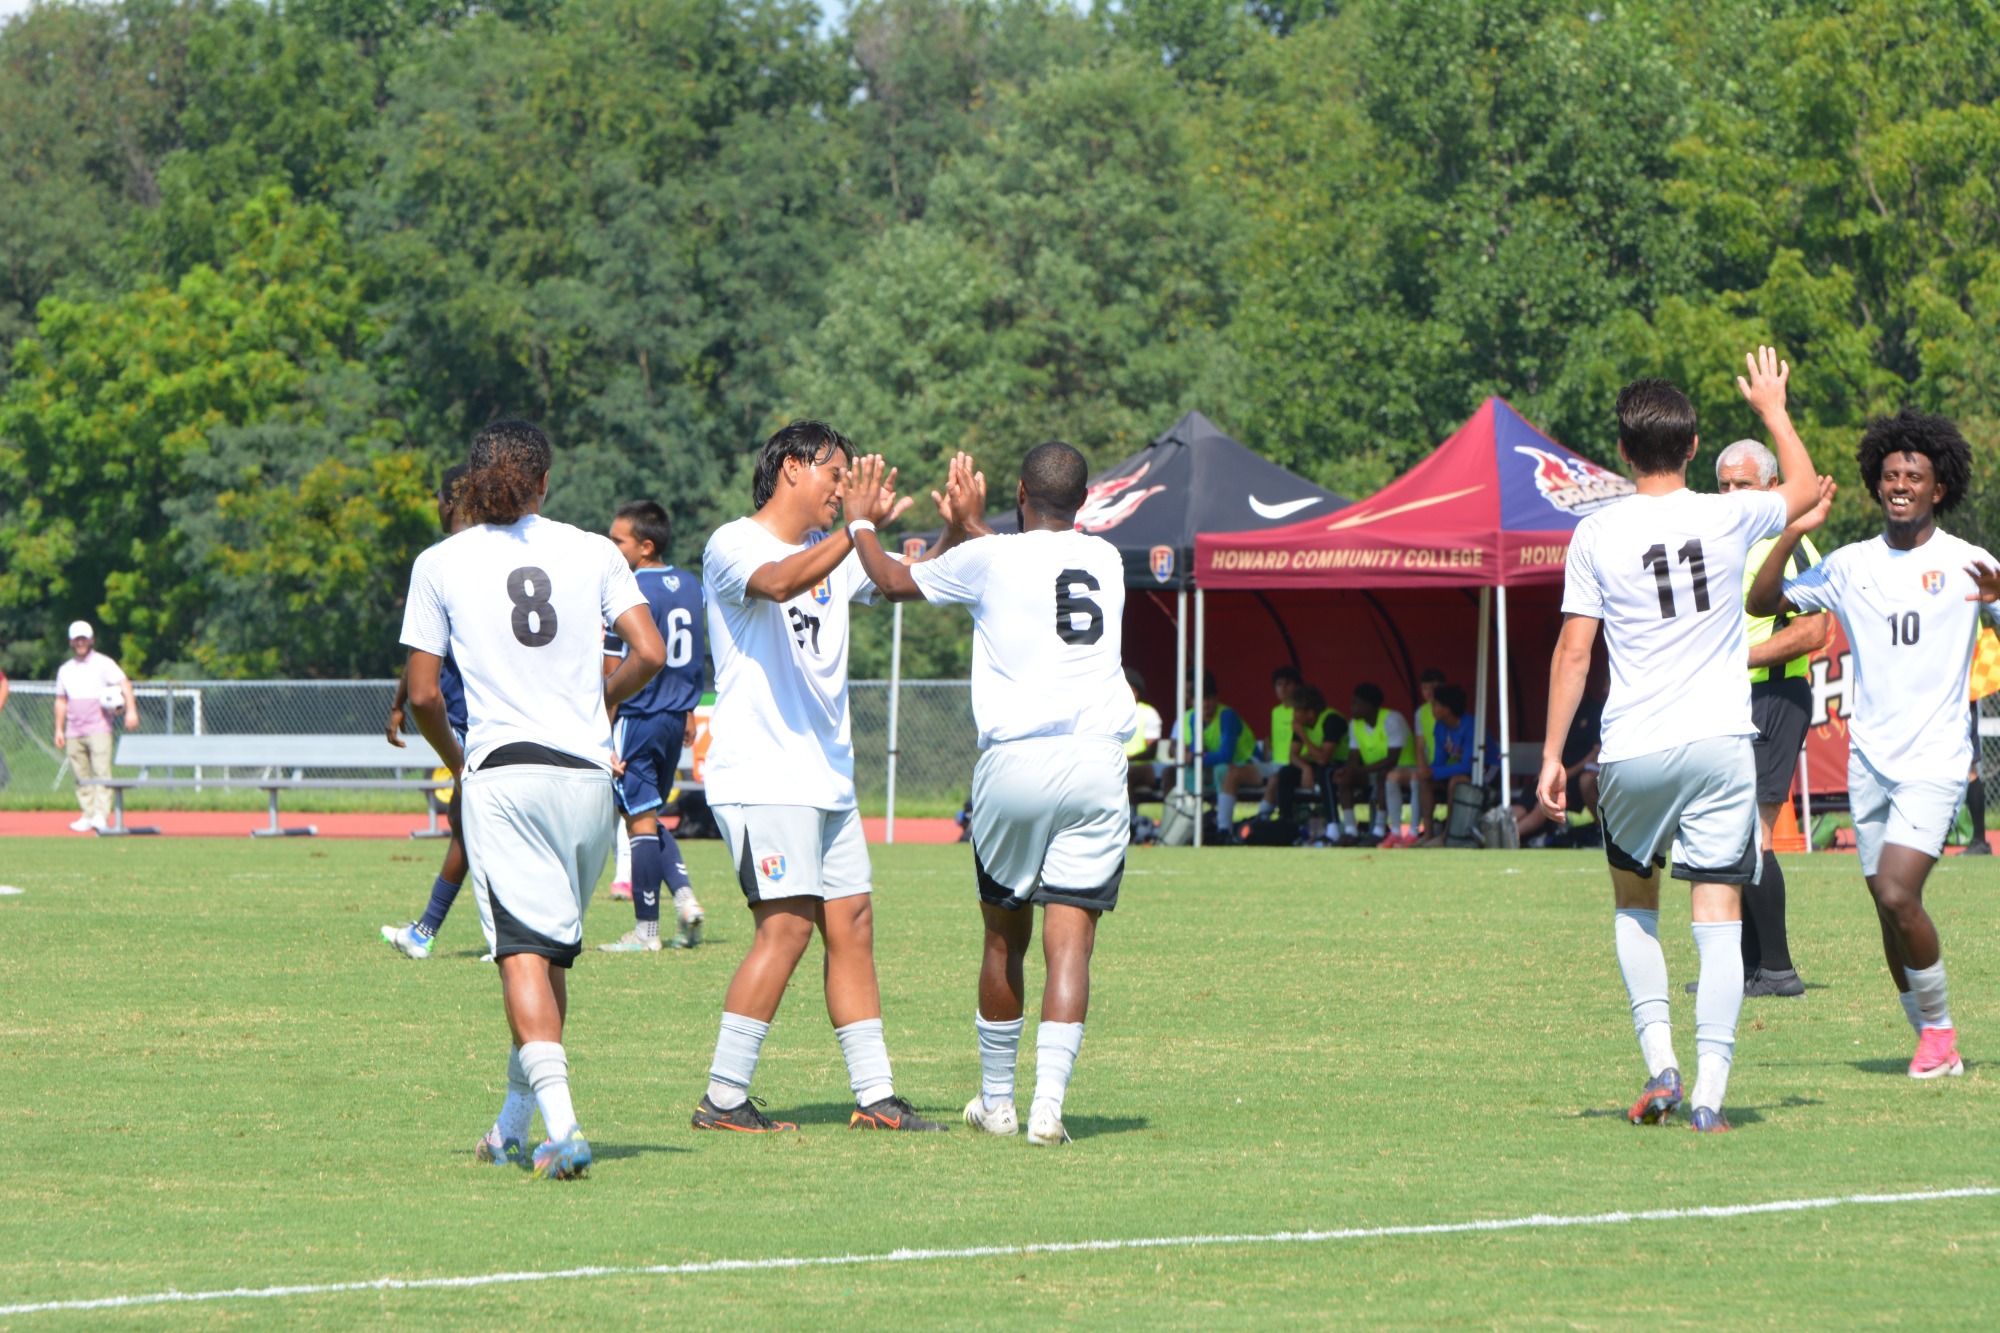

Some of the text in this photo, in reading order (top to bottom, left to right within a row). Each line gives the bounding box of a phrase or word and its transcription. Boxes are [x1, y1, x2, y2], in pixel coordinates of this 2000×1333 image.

[1211, 548, 1483, 570] HOWARD COMMUNITY COLLEGE
[1642, 538, 1711, 619] 11
[506, 566, 558, 648] 8
[788, 606, 821, 655] 27
[1055, 568, 1104, 646] 6
[1887, 610, 1920, 646] 10
[667, 608, 693, 669] 6
